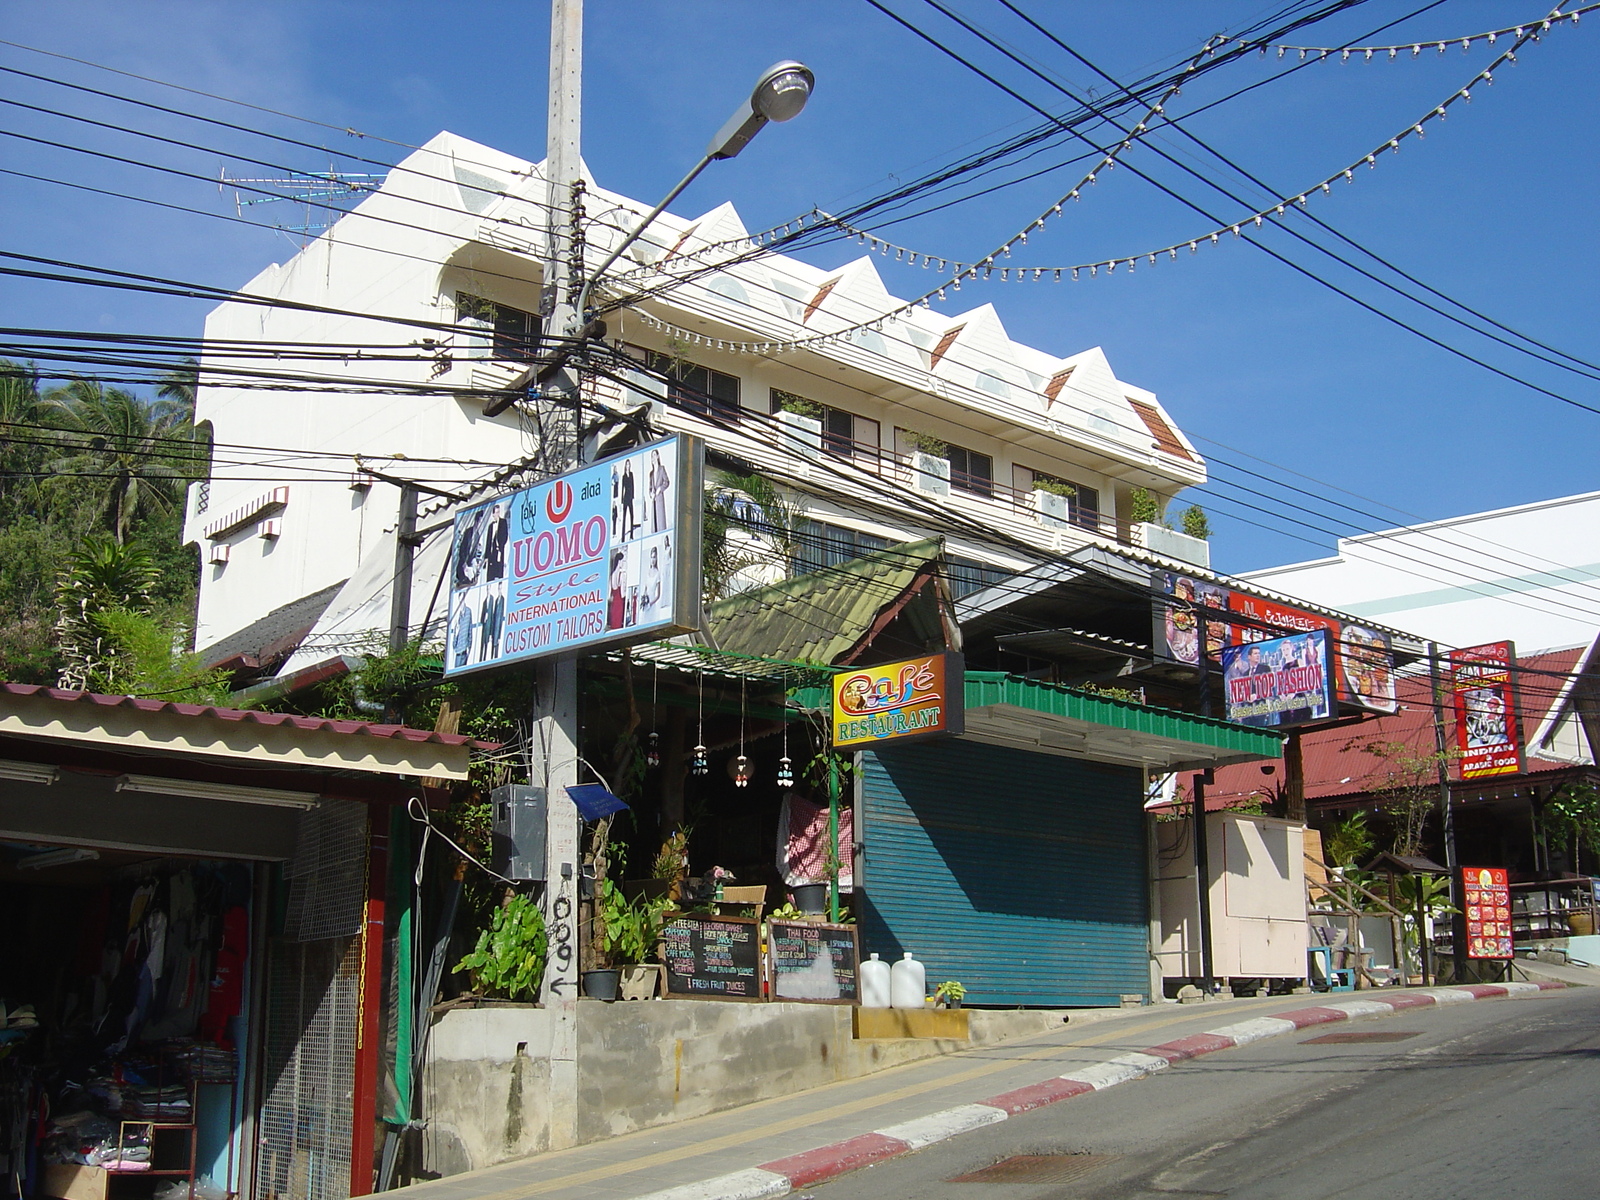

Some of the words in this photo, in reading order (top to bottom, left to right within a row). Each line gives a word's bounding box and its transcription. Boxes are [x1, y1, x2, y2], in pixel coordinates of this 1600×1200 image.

[513, 515, 606, 580] UOMO
[515, 572, 600, 604] Style
[507, 589, 604, 625] INTERNATIONAL
[505, 622, 551, 654] CUSTOM
[556, 609, 604, 642] TAILORS
[838, 659, 938, 716] Café
[1230, 677, 1252, 703] NEW
[1254, 672, 1275, 699] TOP
[1276, 664, 1322, 695] FASHION
[838, 706, 941, 741] RESTAURANT
[1463, 760, 1492, 771] ARABIC
[1494, 758, 1517, 767] FOOD
[1464, 744, 1514, 757] INDIAN
[704, 930, 716, 938] HOME
[787, 929, 800, 938] THAI
[803, 930, 819, 938] FOOD
[692, 978, 710, 989] FRESH
[711, 981, 725, 989] FRUIT
[726, 982, 746, 991] JUICES
